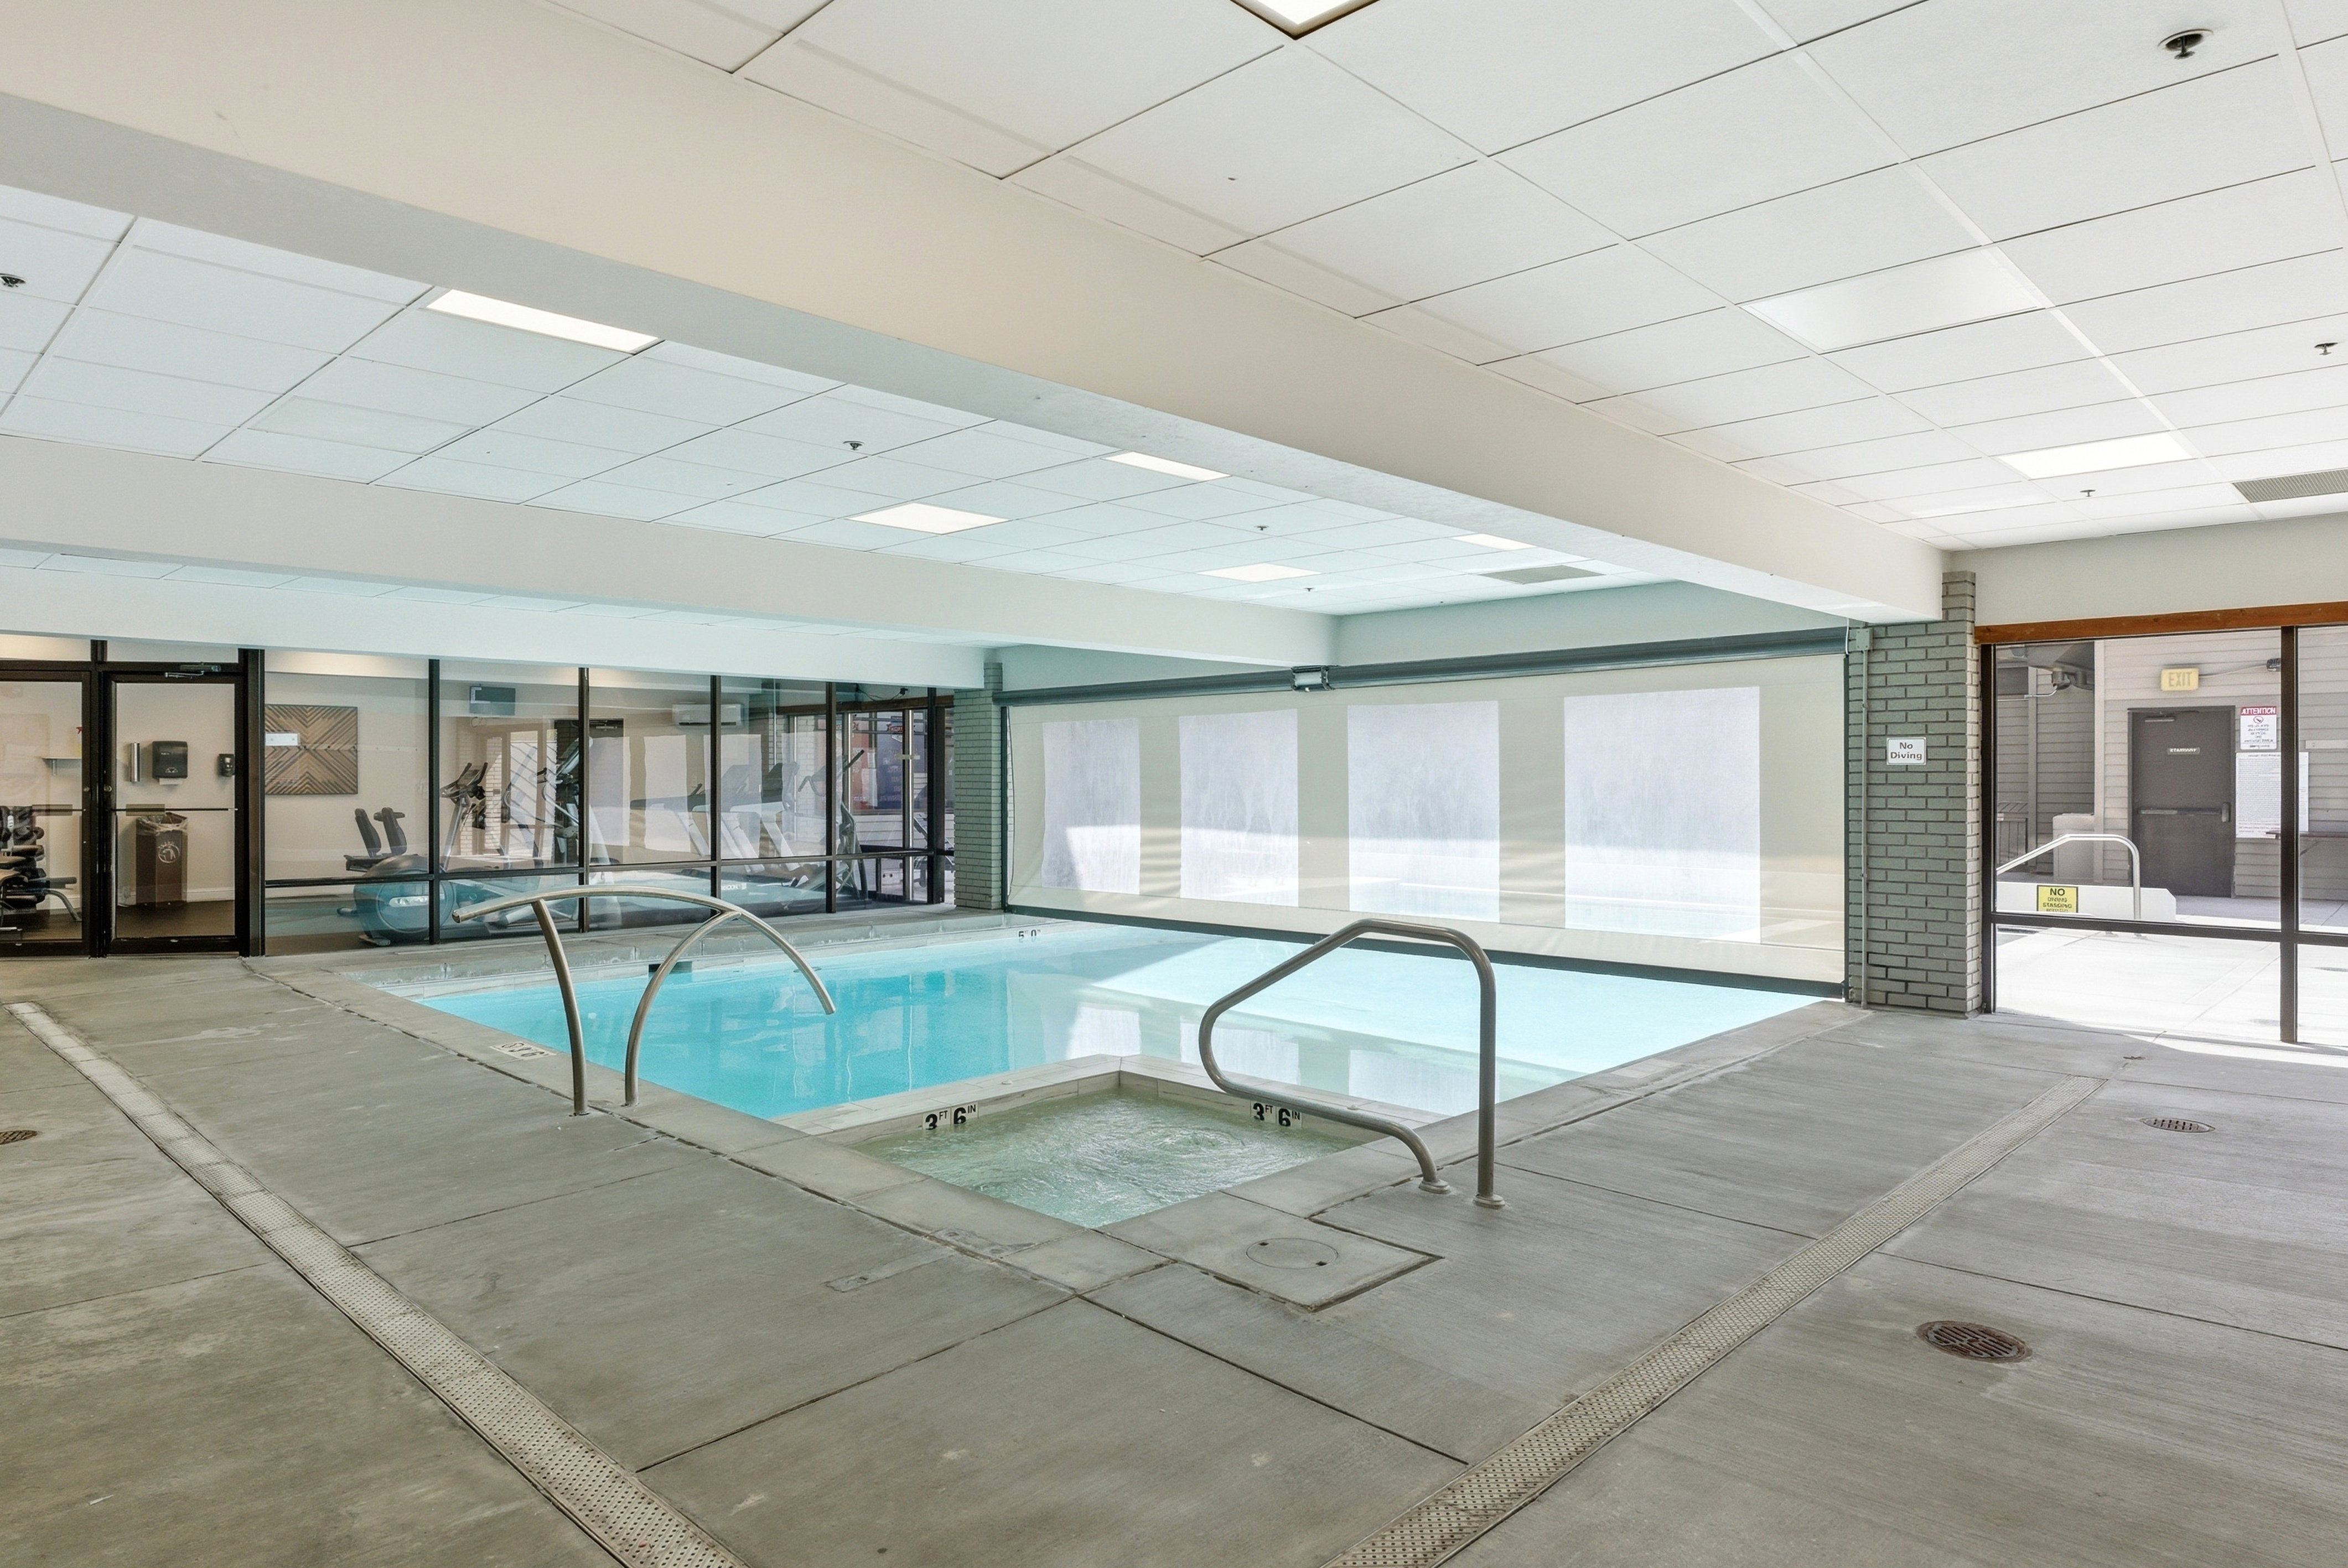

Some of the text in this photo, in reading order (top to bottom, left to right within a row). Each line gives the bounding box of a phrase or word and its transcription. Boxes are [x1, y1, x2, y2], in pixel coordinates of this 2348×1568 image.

[2169, 672, 2192, 687] EXIT
[1890, 752, 1922, 761] Diving
[2050, 888, 2065, 896] NO
[925, 1104, 976, 1130] 3 FT 6 IN
[1253, 1102, 1300, 1127] 3 FT 6 IN
